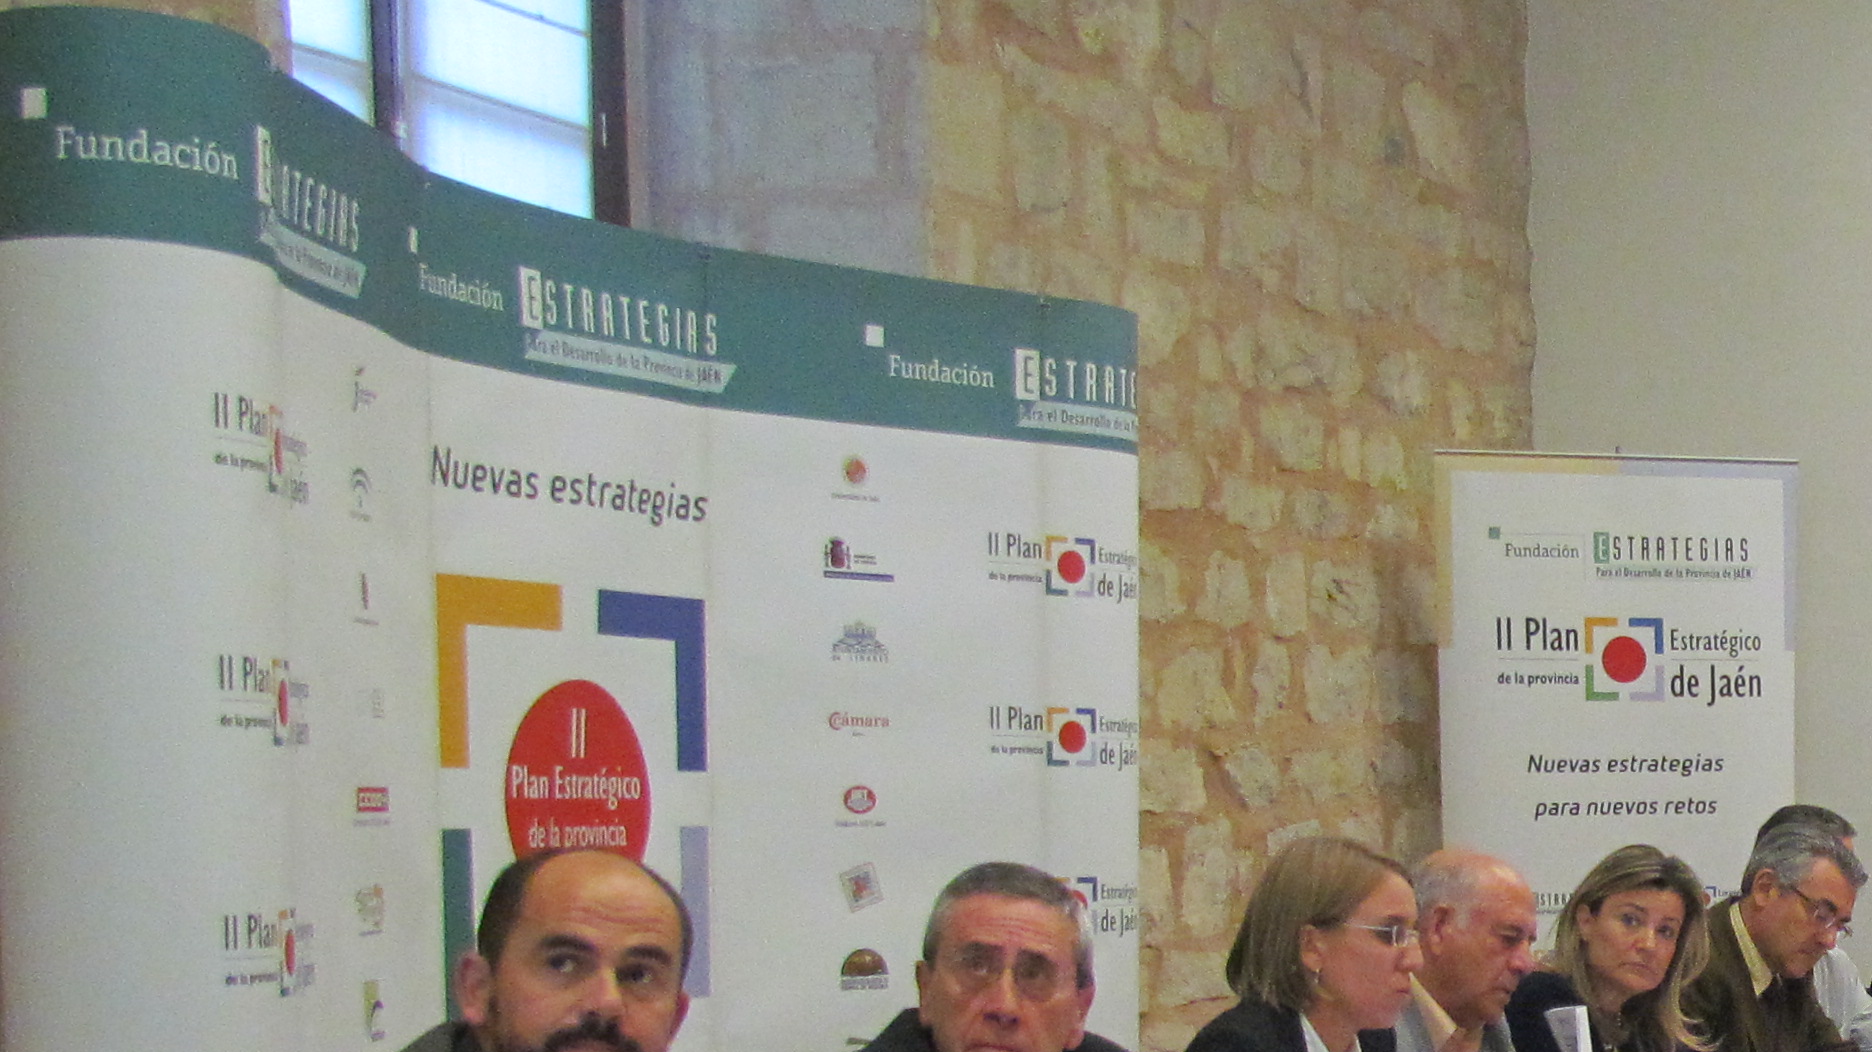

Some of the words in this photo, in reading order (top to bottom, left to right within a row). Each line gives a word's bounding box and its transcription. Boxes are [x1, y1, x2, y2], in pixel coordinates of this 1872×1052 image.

[55, 124, 239, 180] Fundación
[417, 262, 504, 312] Fundación
[519, 266, 718, 357] ESTRATEGIAS
[888, 354, 995, 389] Fundación
[431, 445, 539, 501] Nuevas
[550, 472, 709, 527] estrategias
[987, 532, 999, 556] II
[1006, 533, 1043, 559] Plan
[1504, 543, 1580, 560] Fundación
[1593, 531, 1749, 564] ESTRATEGIAS
[1098, 573, 1114, 597] de
[1623, 567, 1662, 579] Desarrollo
[1664, 568, 1674, 578] de
[1496, 616, 1513, 652] II
[1525, 616, 1579, 652] Plan
[1670, 628, 1762, 658] Estratégico
[1497, 671, 1511, 686] de
[1513, 671, 1524, 686] la
[1527, 671, 1580, 689] provincia
[1670, 664, 1700, 699] de
[1706, 664, 1763, 707] Jaén
[571, 707, 588, 759] II
[989, 706, 1000, 730] II
[1008, 706, 1044, 731] Plan
[1100, 742, 1115, 765] de
[1527, 754, 1600, 774] Nuevas
[1607, 753, 1724, 777] estrategias
[511, 764, 550, 799] Plan
[554, 766, 642, 811] Estratégico
[1534, 800, 1580, 821] para
[1587, 799, 1659, 816] nuevos
[1665, 798, 1717, 816] retos
[528, 818, 545, 848] de
[550, 818, 560, 848] la
[564, 818, 628, 849] provincia
[1101, 908, 1117, 932] de
